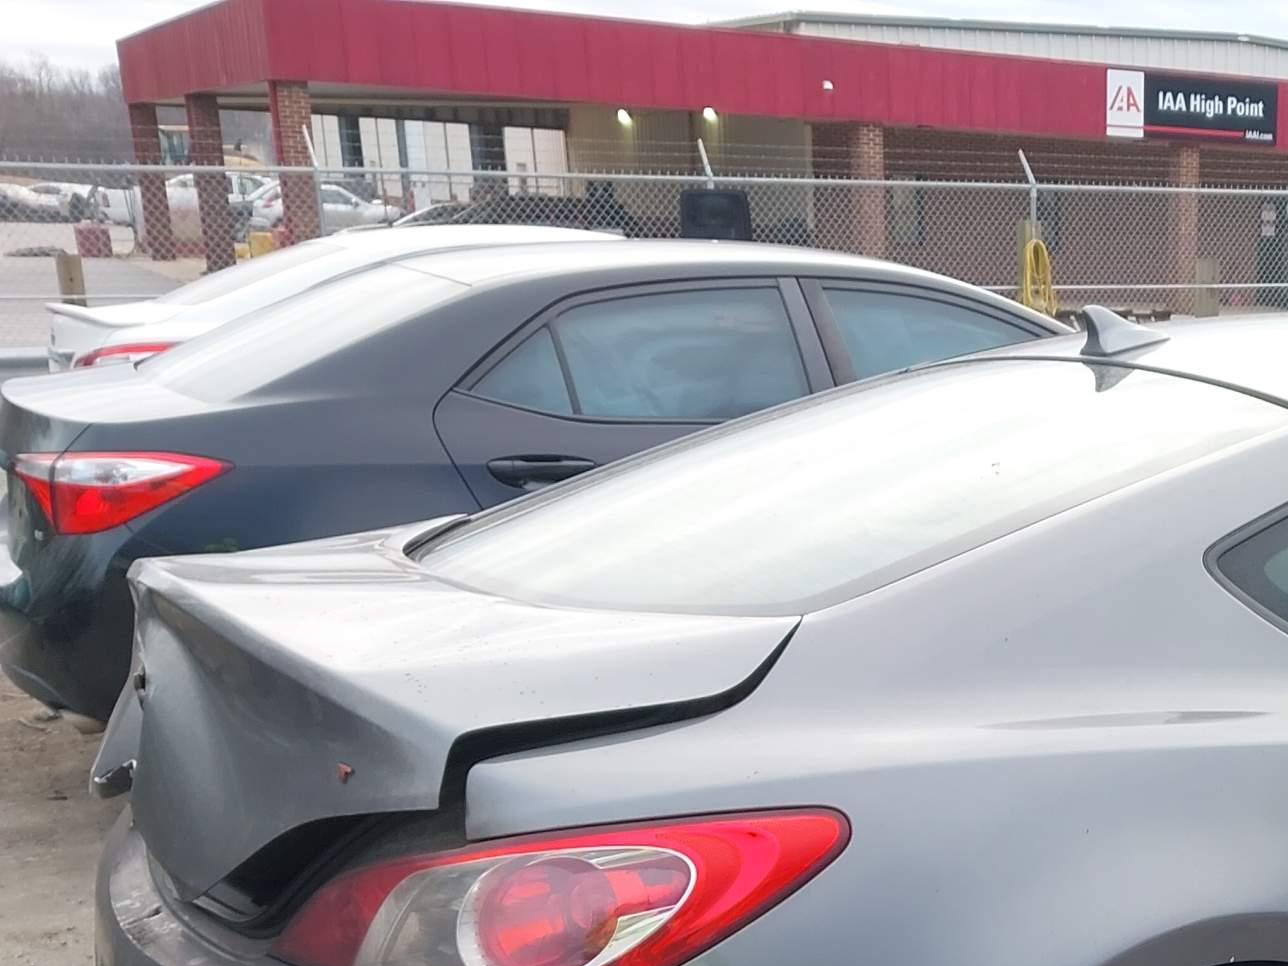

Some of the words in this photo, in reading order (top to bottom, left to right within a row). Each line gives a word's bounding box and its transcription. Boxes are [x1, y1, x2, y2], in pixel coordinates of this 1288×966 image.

[1158, 91, 1186, 112] IAA
[1189, 94, 1223, 118] High
[1227, 97, 1264, 117] Point
